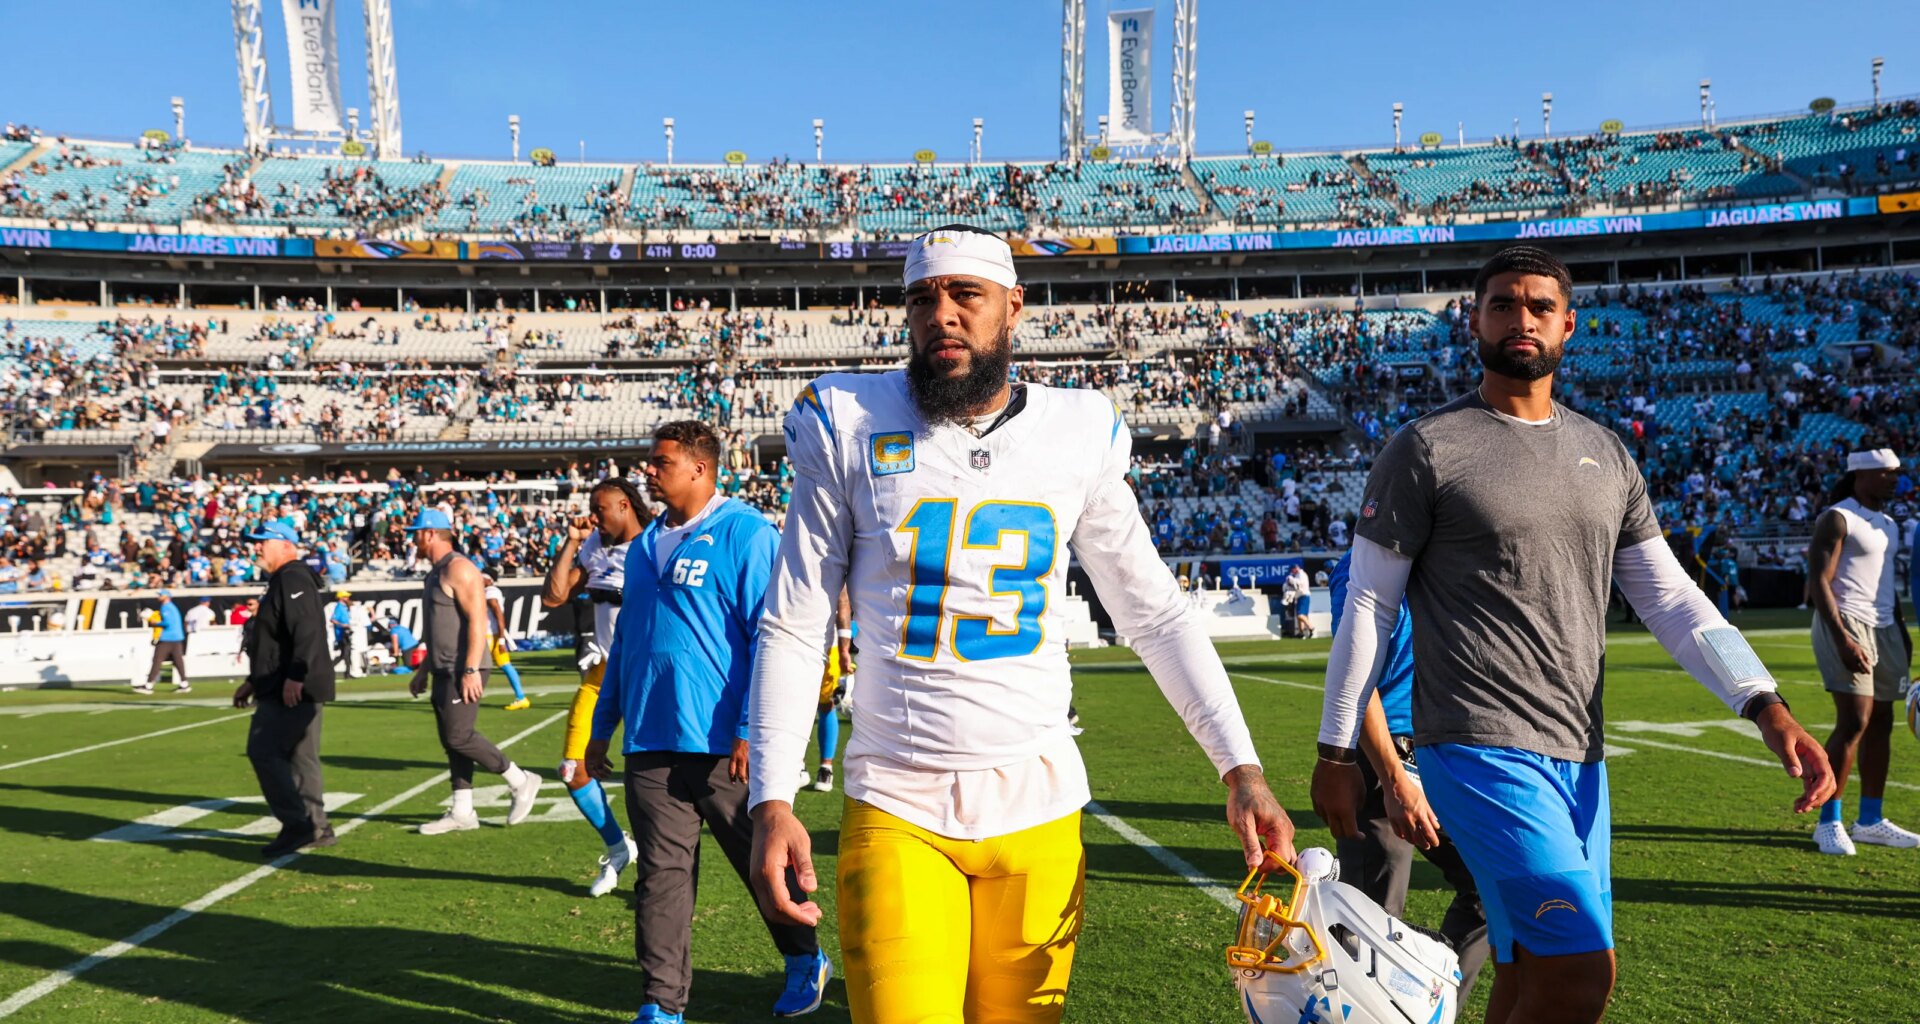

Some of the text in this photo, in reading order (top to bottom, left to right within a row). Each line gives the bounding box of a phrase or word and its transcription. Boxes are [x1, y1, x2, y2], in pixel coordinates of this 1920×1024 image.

[301, 16, 328, 114] EverBank
[1121, 37, 1138, 129] EverBank
[1705, 201, 1841, 228] JAGUARS WIN
[1, 228, 50, 248] WIN
[1332, 226, 1455, 247] JAGUARS WIN
[1515, 217, 1642, 239] JAGUARS WIN
[128, 235, 278, 256] JAGUARS WIN
[609, 243, 622, 260] 6
[646, 244, 716, 259] 4TH 0:00
[830, 243, 854, 259] 35
[1150, 234, 1272, 253] JAGUARS WIN
[499, 439, 653, 449] INSURANCE
[874, 433, 912, 463] C
[672, 558, 709, 588] 62
[897, 497, 1059, 662] 13
[1238, 566, 1264, 578] CBS
